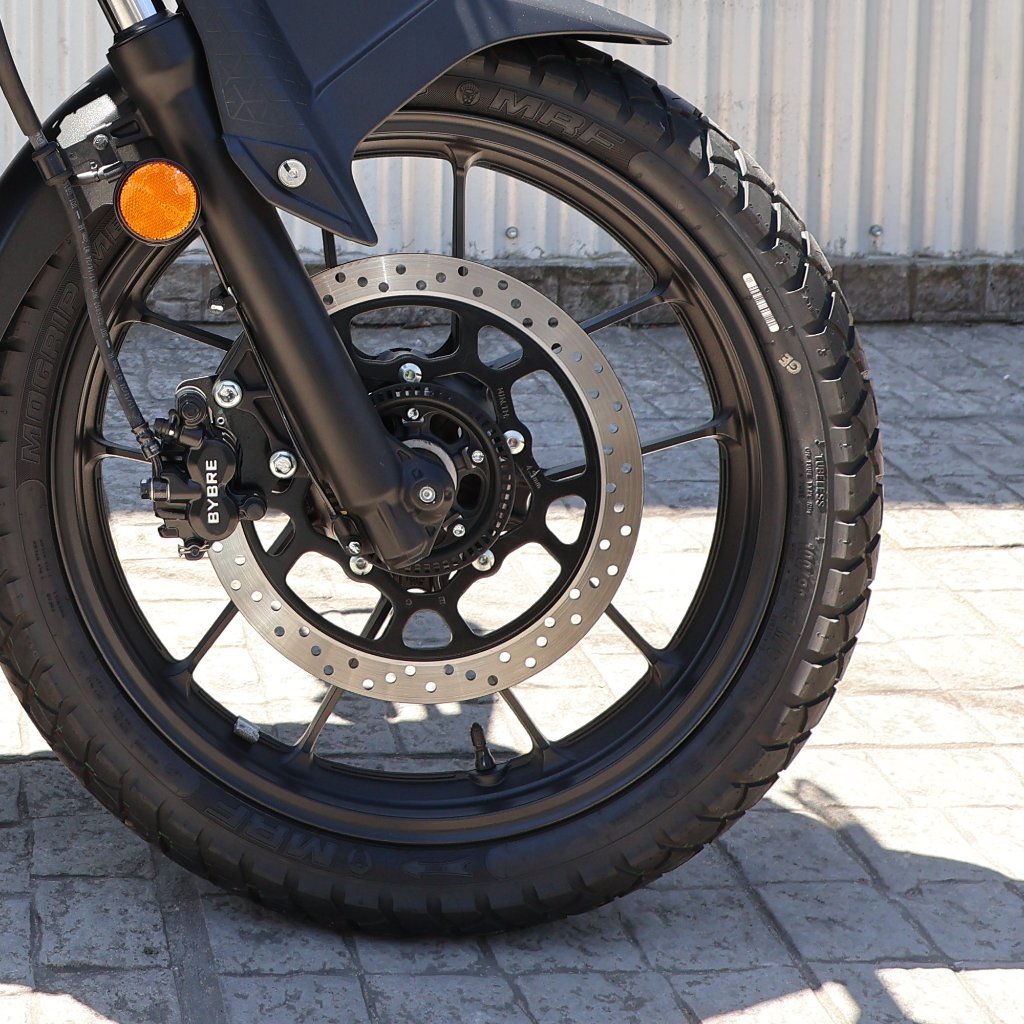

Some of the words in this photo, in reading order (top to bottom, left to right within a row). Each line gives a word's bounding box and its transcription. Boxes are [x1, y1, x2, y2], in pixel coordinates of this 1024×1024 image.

[487, 87, 626, 150] MRF
[21, 281, 79, 464] MOGRIP
[205, 459, 221, 524] BYBRE
[814, 453, 825, 508] TUBELESS
